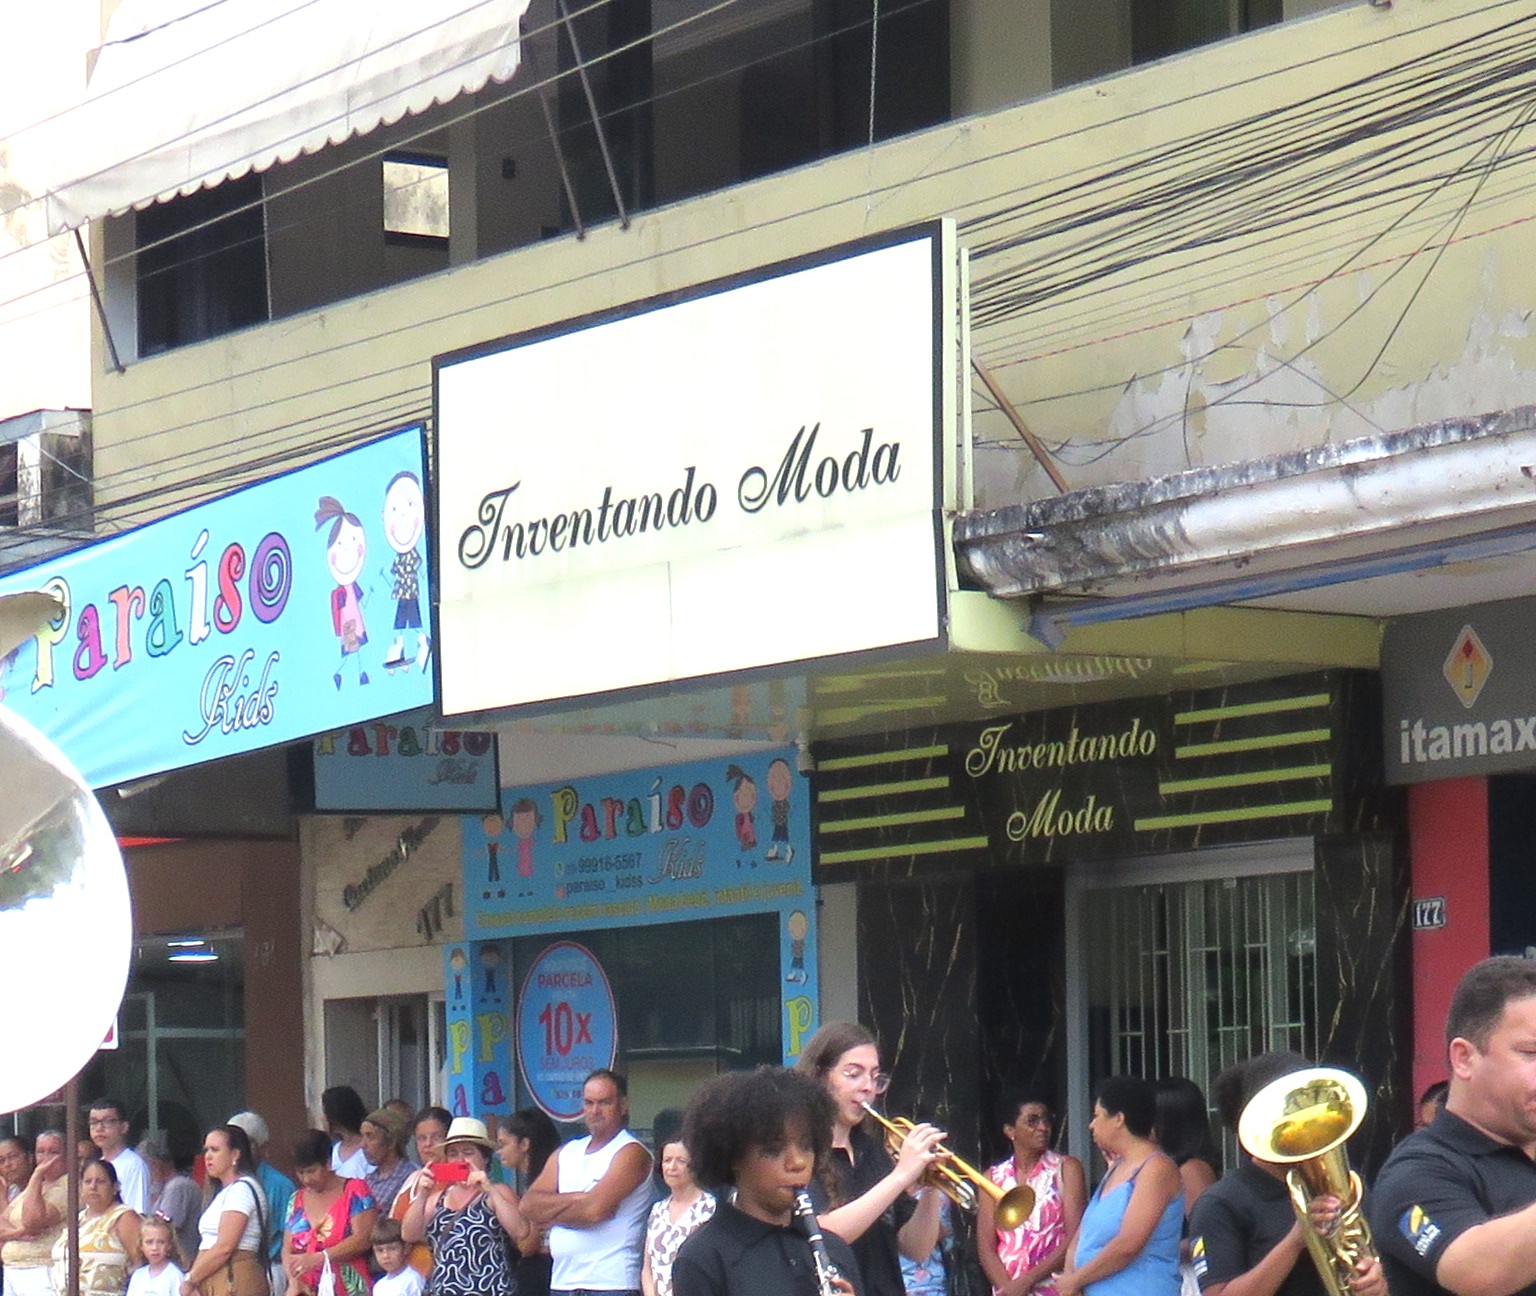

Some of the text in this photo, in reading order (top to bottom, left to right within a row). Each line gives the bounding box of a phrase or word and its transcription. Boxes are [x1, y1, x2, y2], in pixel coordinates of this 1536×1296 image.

[458, 421, 902, 570] Inventando Moda
[31, 528, 293, 695] Paraíso
[182, 648, 281, 746] Kids
[965, 718, 1158, 778] Inventando
[551, 776, 714, 845] Paraíso
[1006, 790, 1114, 842] Moda
[646, 838, 708, 885] Kids
[1416, 900, 1442, 927] 177
[537, 972, 594, 989] PARCELA
[539, 1001, 593, 1058] 10x
